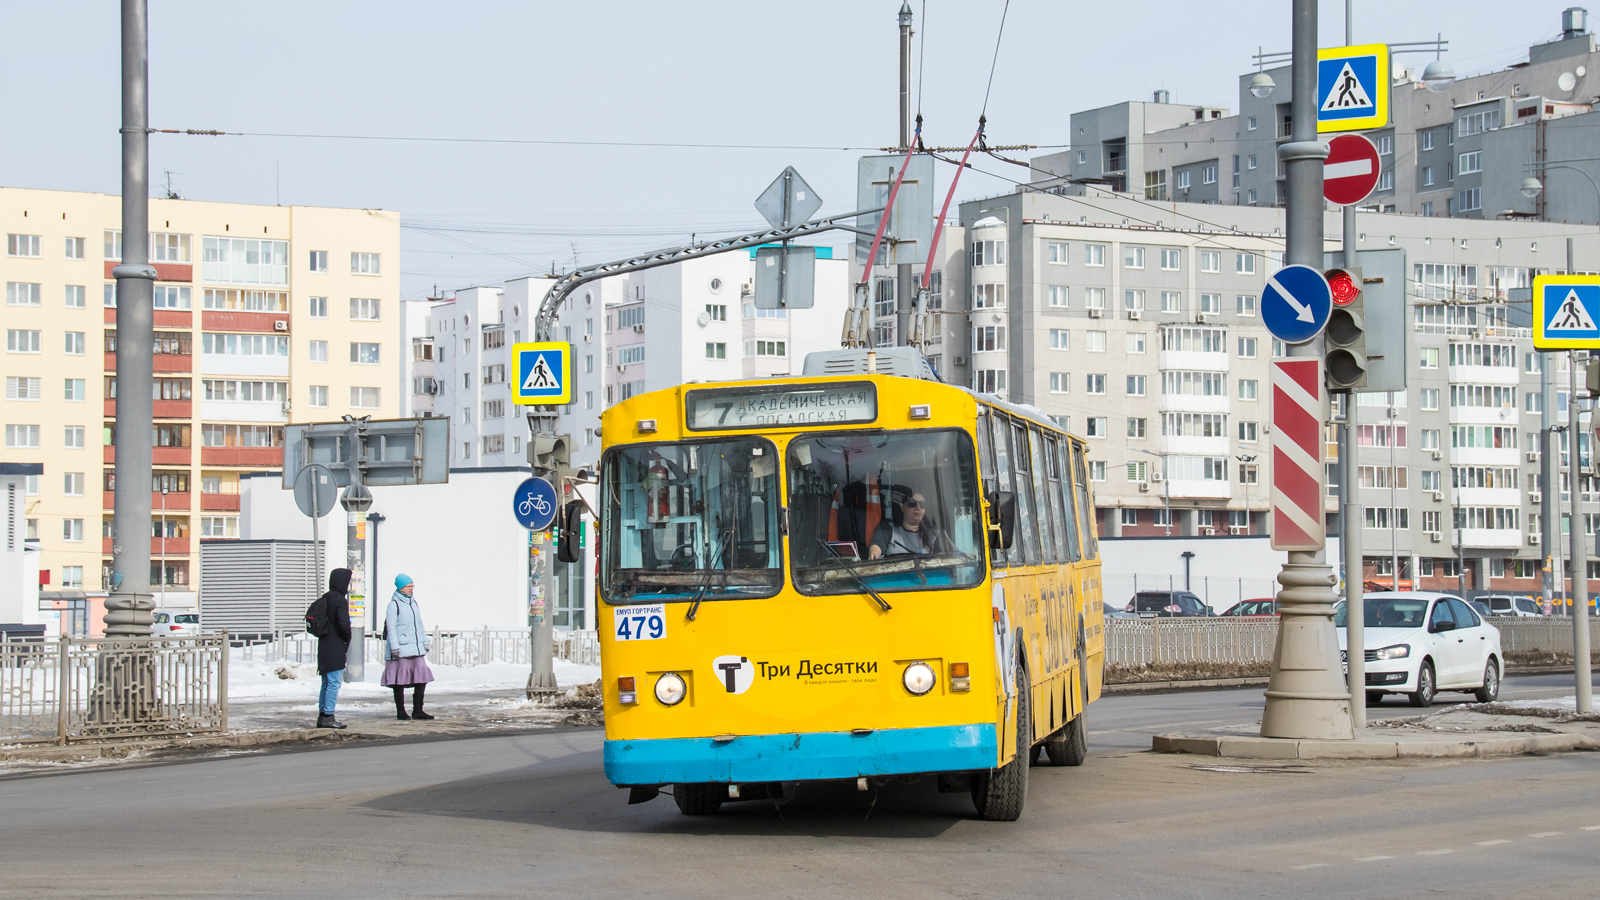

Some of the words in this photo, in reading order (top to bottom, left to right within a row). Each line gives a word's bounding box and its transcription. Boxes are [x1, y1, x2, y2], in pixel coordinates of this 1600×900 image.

[738, 392, 866, 412] АКАДЕМИЧЕСКАЯ
[713, 402, 734, 426] 7
[617, 615, 663, 640] 479
[757, 661, 791, 681] Три
[796, 660, 878, 680] Десятки
